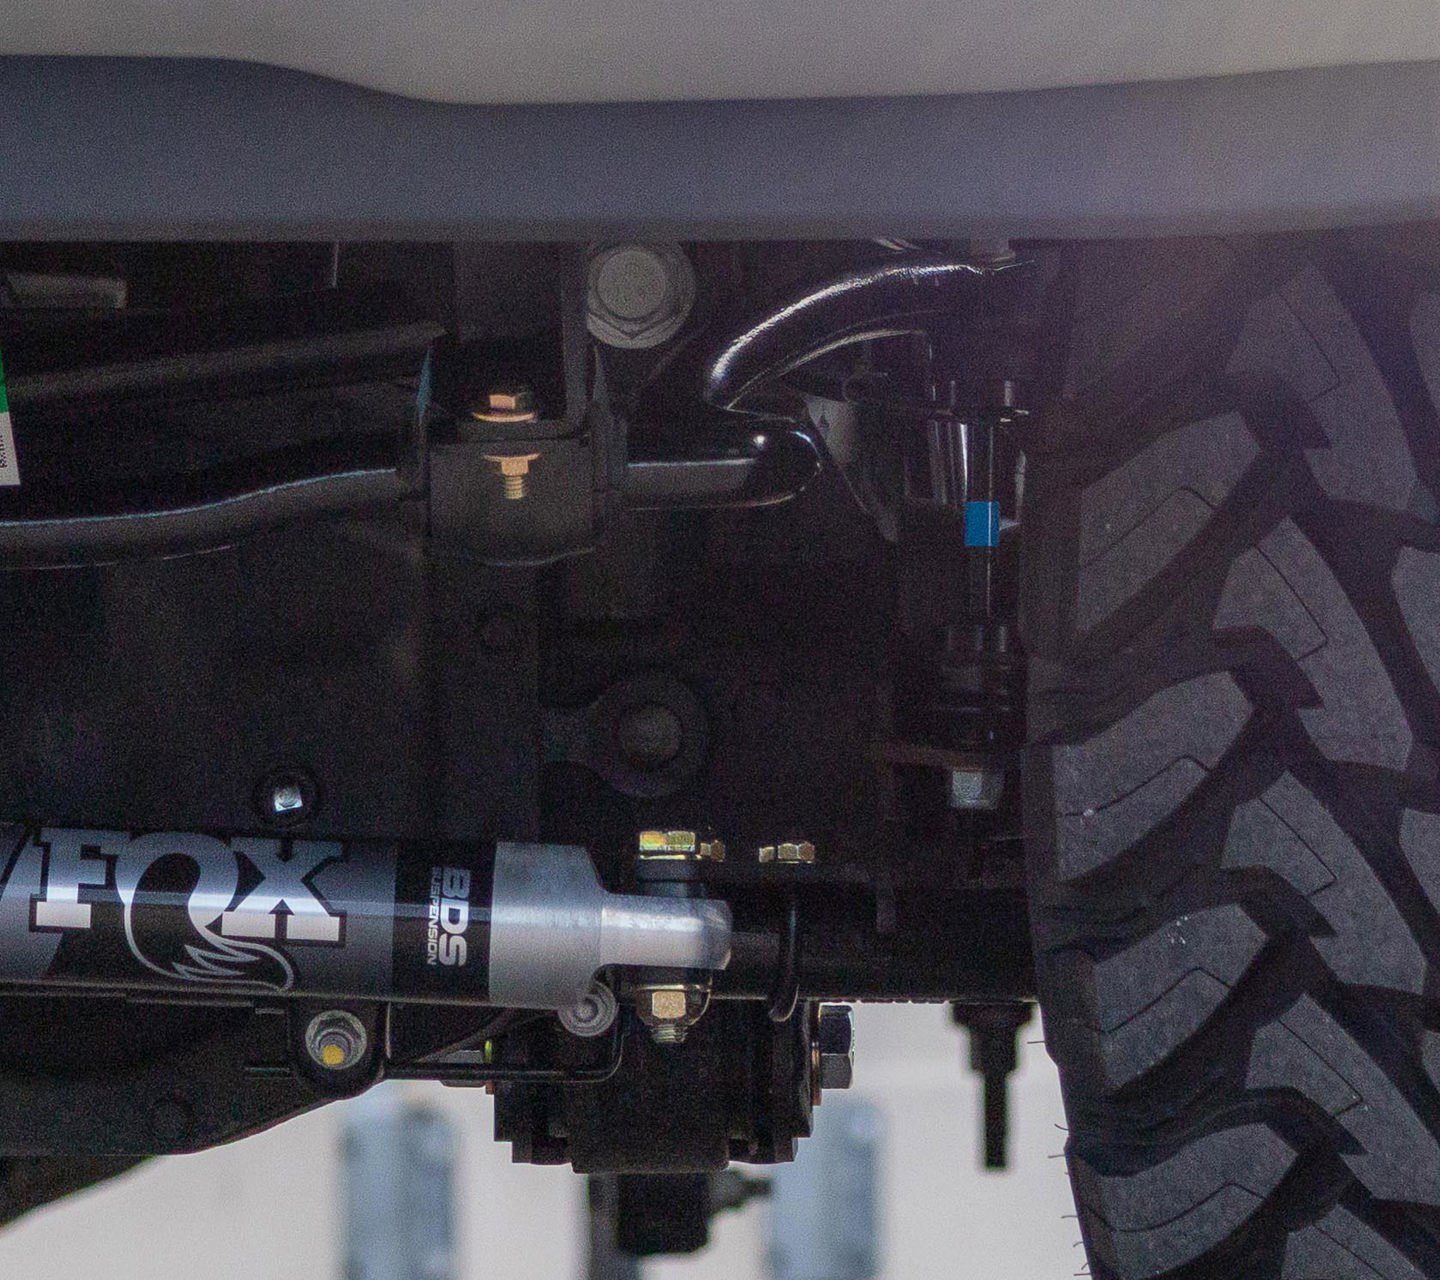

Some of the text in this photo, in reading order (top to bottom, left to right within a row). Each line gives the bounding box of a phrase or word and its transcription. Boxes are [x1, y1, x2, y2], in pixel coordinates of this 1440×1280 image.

[32, 826, 346, 990] FOX
[426, 865, 442, 966] SUSPENSION
[438, 866, 471, 968] BDS
